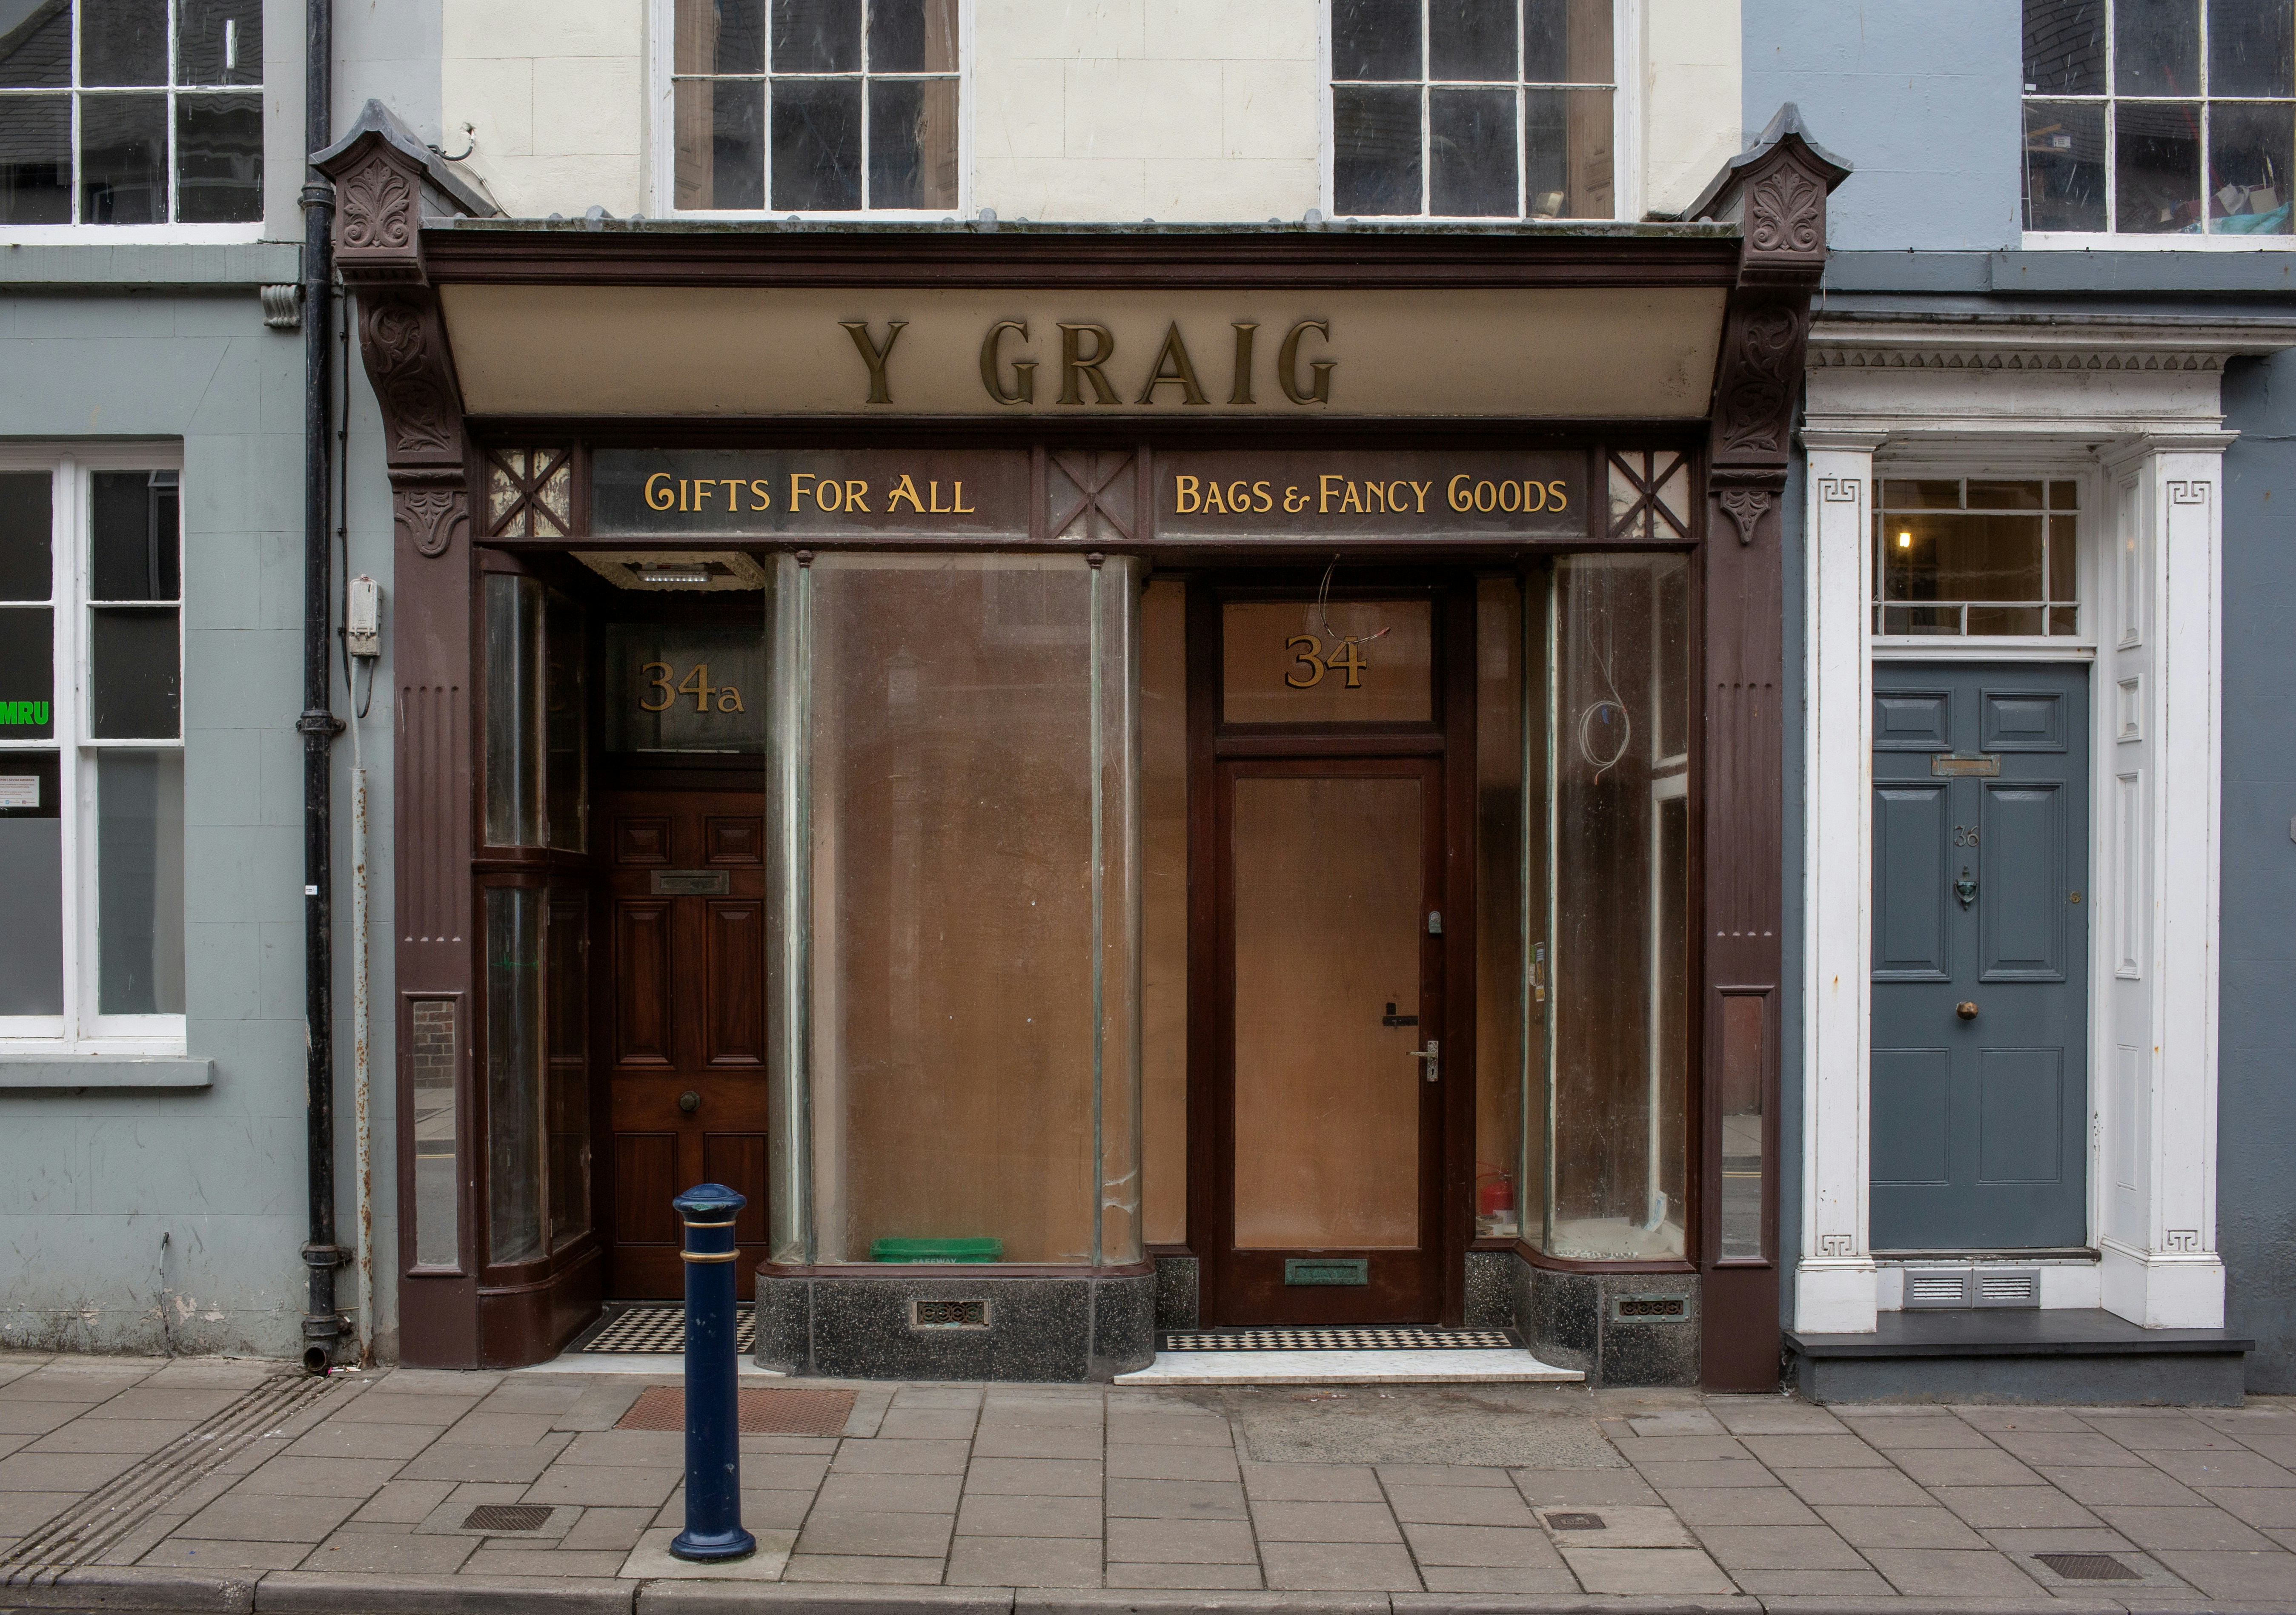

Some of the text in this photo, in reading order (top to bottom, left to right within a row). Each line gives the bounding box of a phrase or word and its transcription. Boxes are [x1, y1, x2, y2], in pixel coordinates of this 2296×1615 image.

[837, 319, 1339, 406] Y GRAIG
[644, 473, 976, 513] GIFTS FOR ALL
[1175, 474, 1568, 513] BAGS & FANCY GOODS
[1285, 634, 1368, 689] 34
[638, 662, 746, 714] 34a
[0, 701, 49, 725] MRU
[1953, 825, 1979, 847] 36
